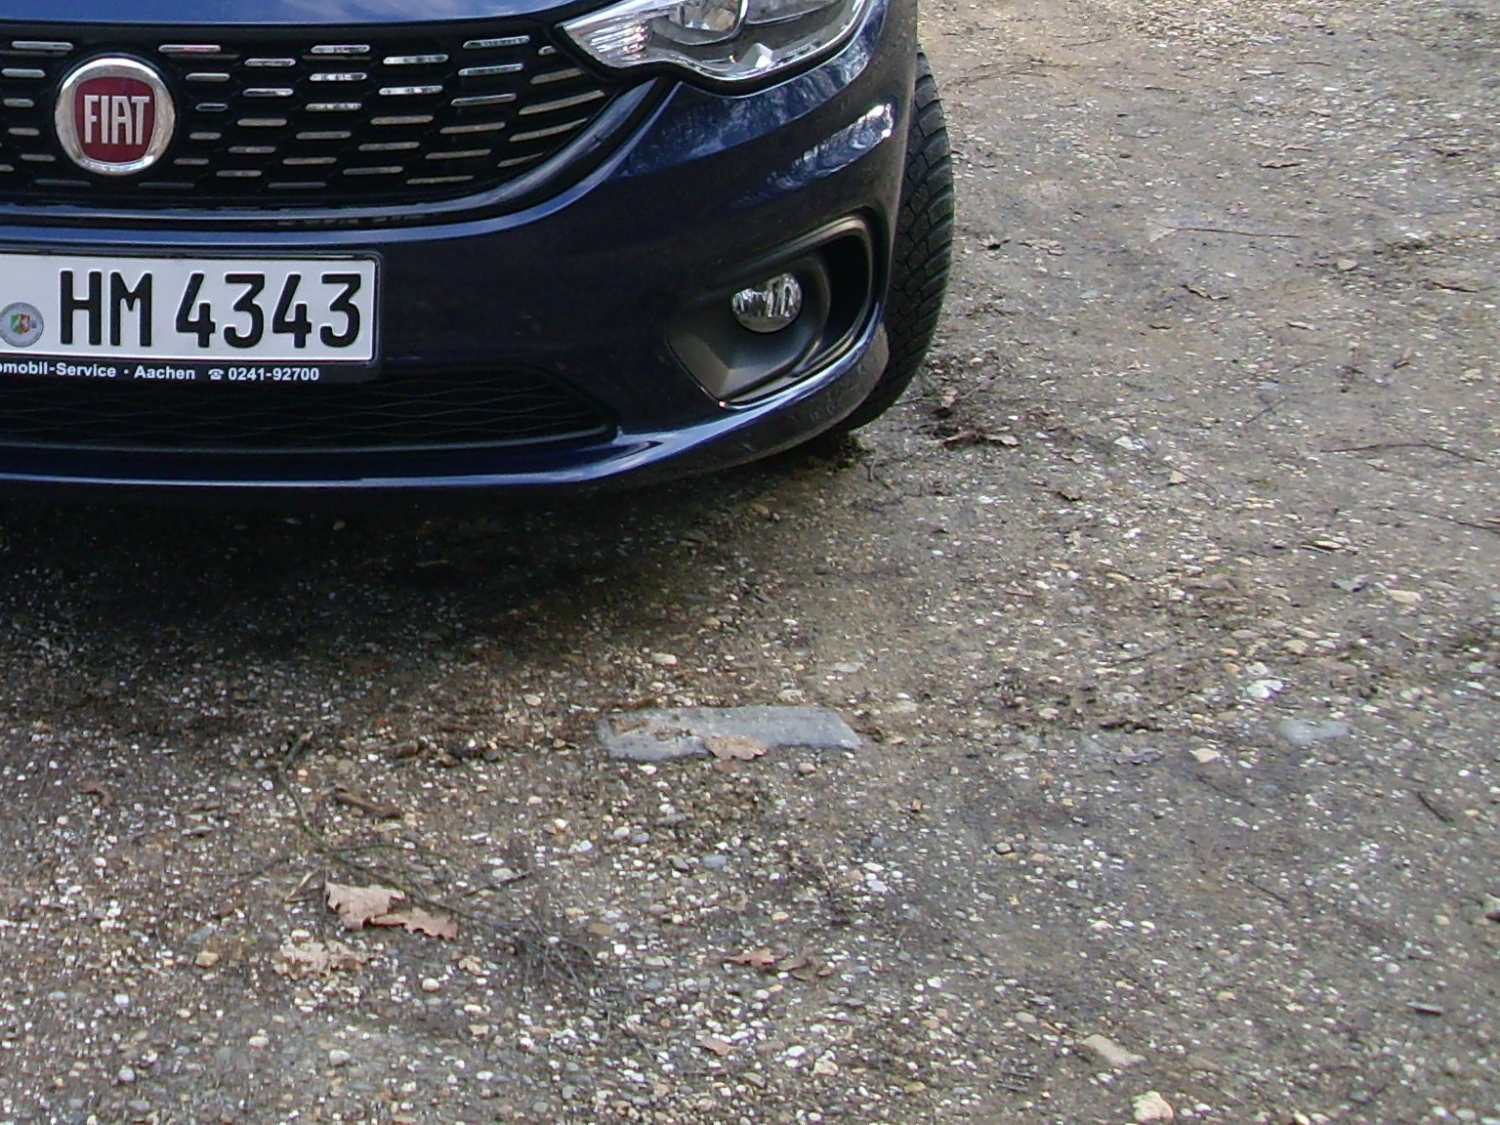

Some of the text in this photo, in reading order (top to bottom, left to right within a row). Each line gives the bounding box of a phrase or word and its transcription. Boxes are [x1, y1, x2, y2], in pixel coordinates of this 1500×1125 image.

[84, 94, 150, 145] FIAT
[60, 270, 153, 347] HM
[175, 272, 362, 349] 4343
[134, 364, 196, 380] Aachen
[228, 368, 320, 381] 0241-92700
